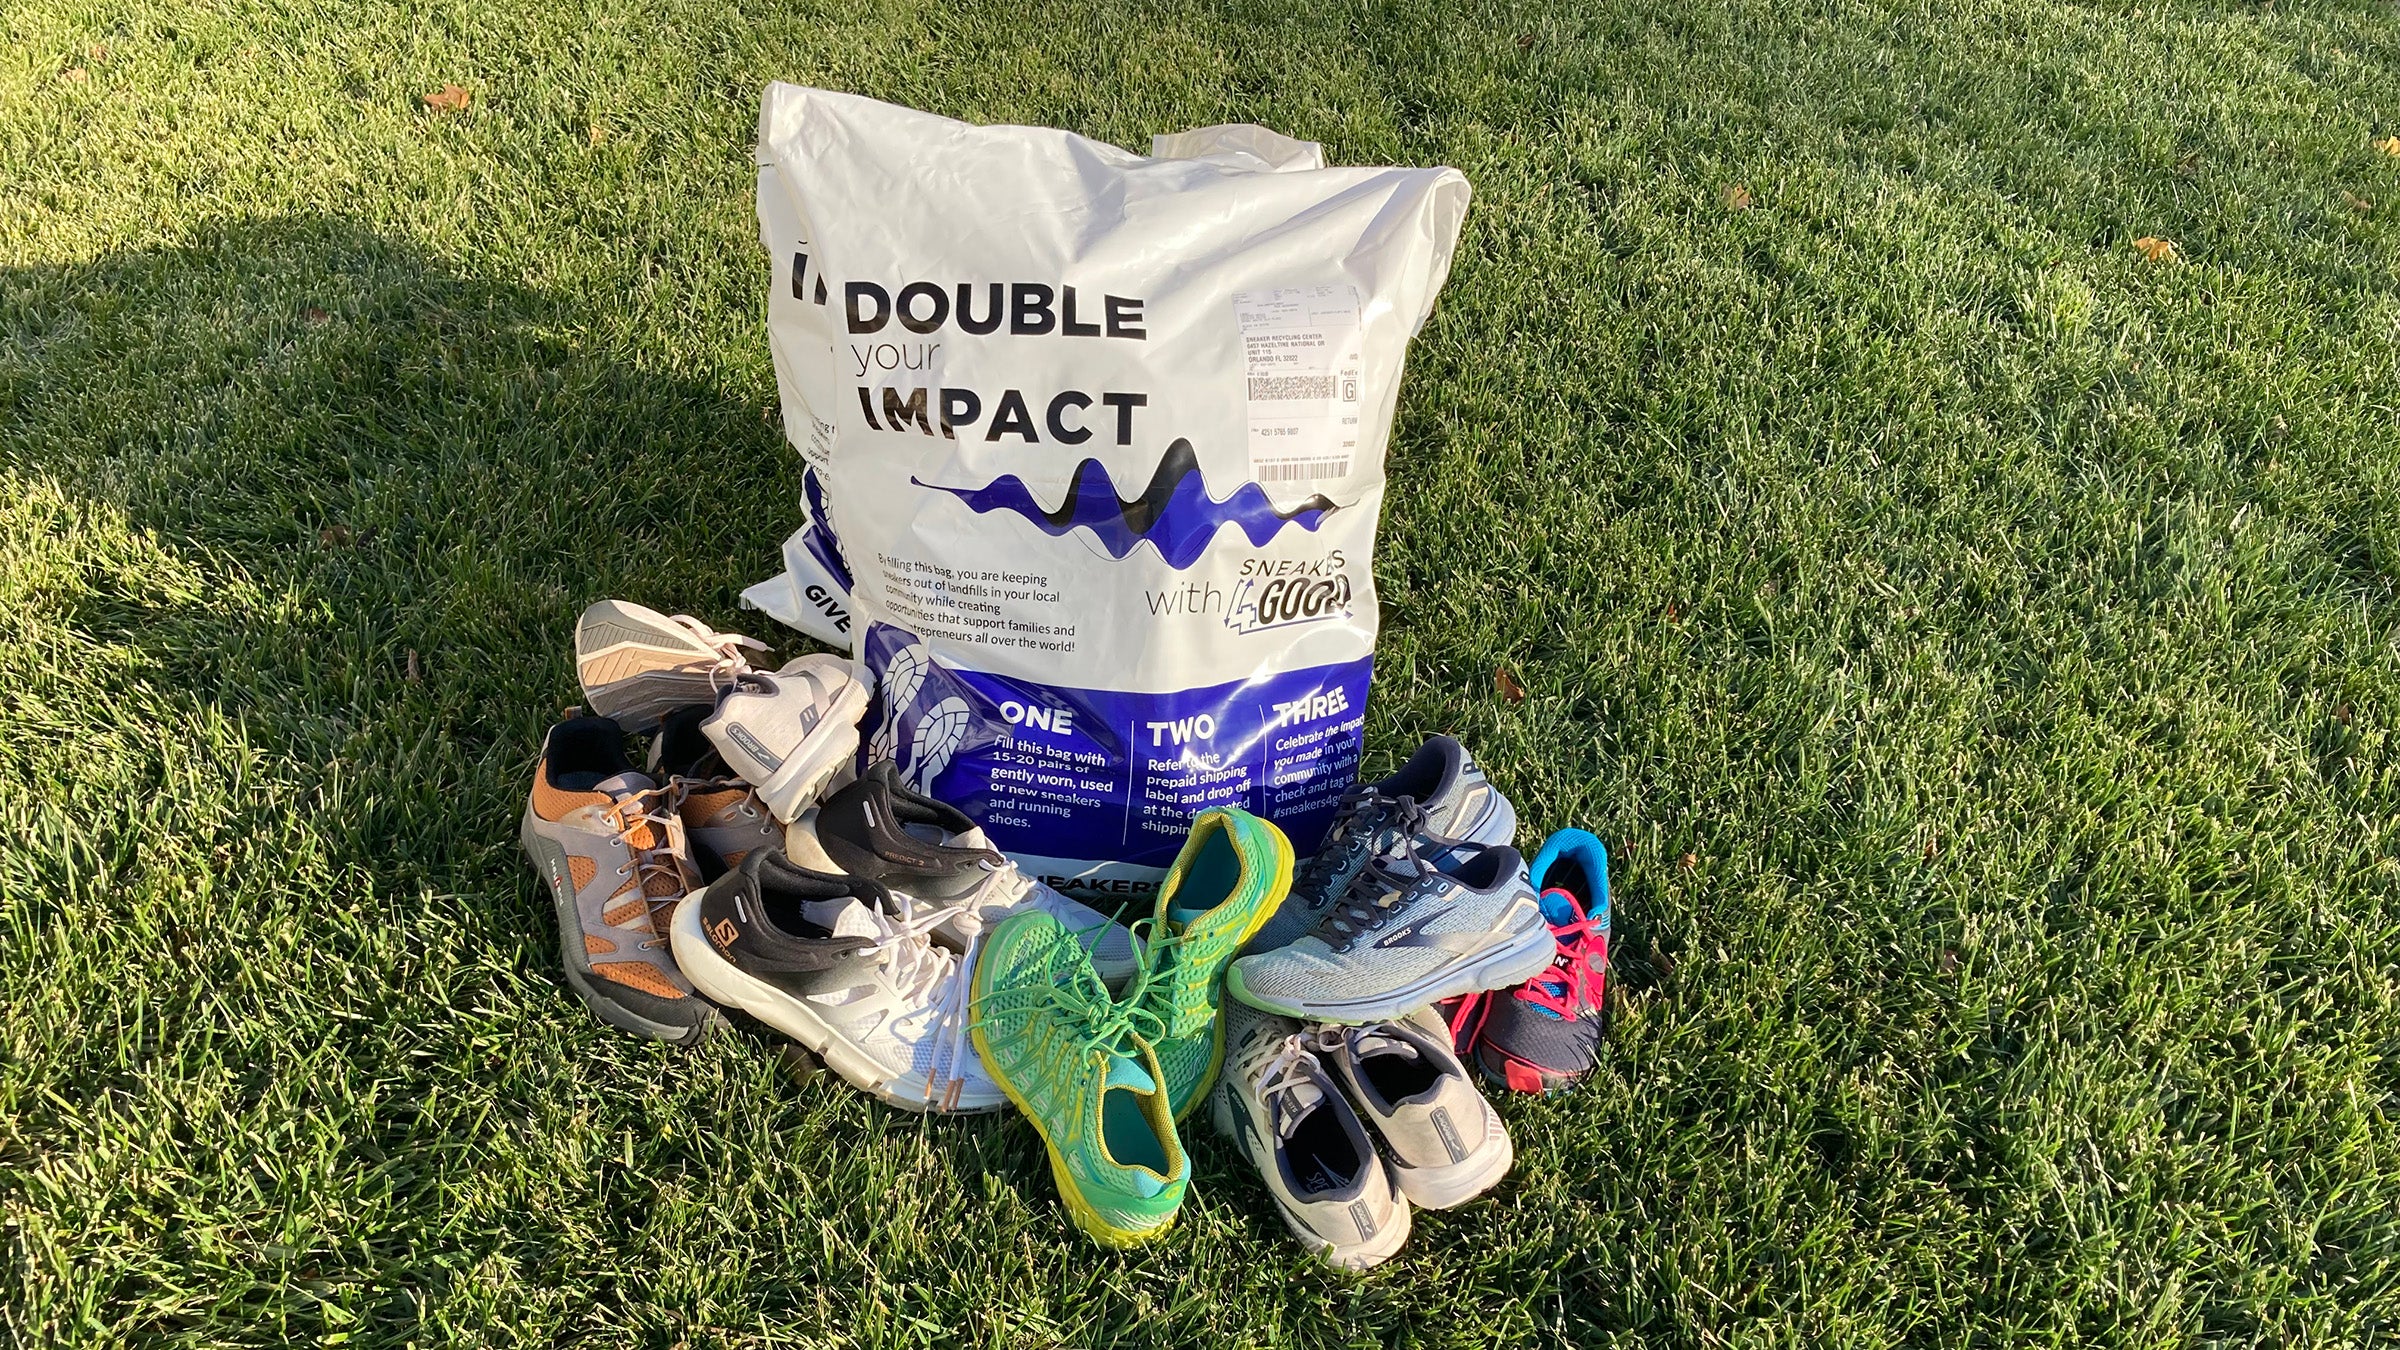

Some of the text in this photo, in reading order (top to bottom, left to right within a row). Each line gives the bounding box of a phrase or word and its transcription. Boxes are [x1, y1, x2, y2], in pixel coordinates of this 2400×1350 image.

[845, 281, 1147, 340] DOUBLE
[850, 342, 940, 377] your
[858, 386, 1147, 445] IMPACT
[914, 561, 933, 574] this
[934, 565, 955, 580] bag,
[957, 570, 978, 581] you
[981, 571, 999, 582] are
[1002, 571, 1048, 587] keeping
[1240, 550, 1346, 577] SNEAKS
[914, 579, 932, 589] out
[935, 580, 946, 590] of
[947, 582, 988, 597] landfills
[991, 586, 1001, 598] in
[1004, 589, 1031, 603] your
[1032, 590, 1060, 602] local
[1145, 581, 1222, 615] with
[805, 584, 851, 634] GIVE
[885, 599, 1075, 636] opportunities that support families and
[925, 595, 955, 608] while
[958, 600, 1001, 616] creating
[911, 624, 1075, 653] trepreneurs all over the world!
[999, 700, 1073, 736] ONE
[1272, 685, 1349, 728] THREE
[731, 727, 759, 753] BROOKS
[1146, 713, 1215, 747] TWO
[1275, 730, 1323, 751] Celebrate
[1324, 726, 1339, 738] the
[992, 751, 1090, 774] 15-20 pairs of
[994, 734, 1106, 767] Fill this bag with
[1148, 758, 1182, 772] Refer
[1200, 752, 1221, 764] the
[1273, 737, 1357, 771] you made in your
[991, 767, 1114, 793] gently worn, used
[1146, 766, 1248, 790] prepaid shipping
[1274, 753, 1359, 785] community with a
[990, 782, 1101, 808] or new sneakers
[1145, 778, 1252, 804] label and drop off
[1275, 772, 1355, 803] check and tag us
[988, 812, 1031, 828] shoes.
[989, 798, 1072, 818] and running
[1143, 805, 1158, 816] at
[1161, 806, 1184, 820] the
[1142, 820, 1191, 836] shippin
[1383, 927, 1412, 946] BROOKS
